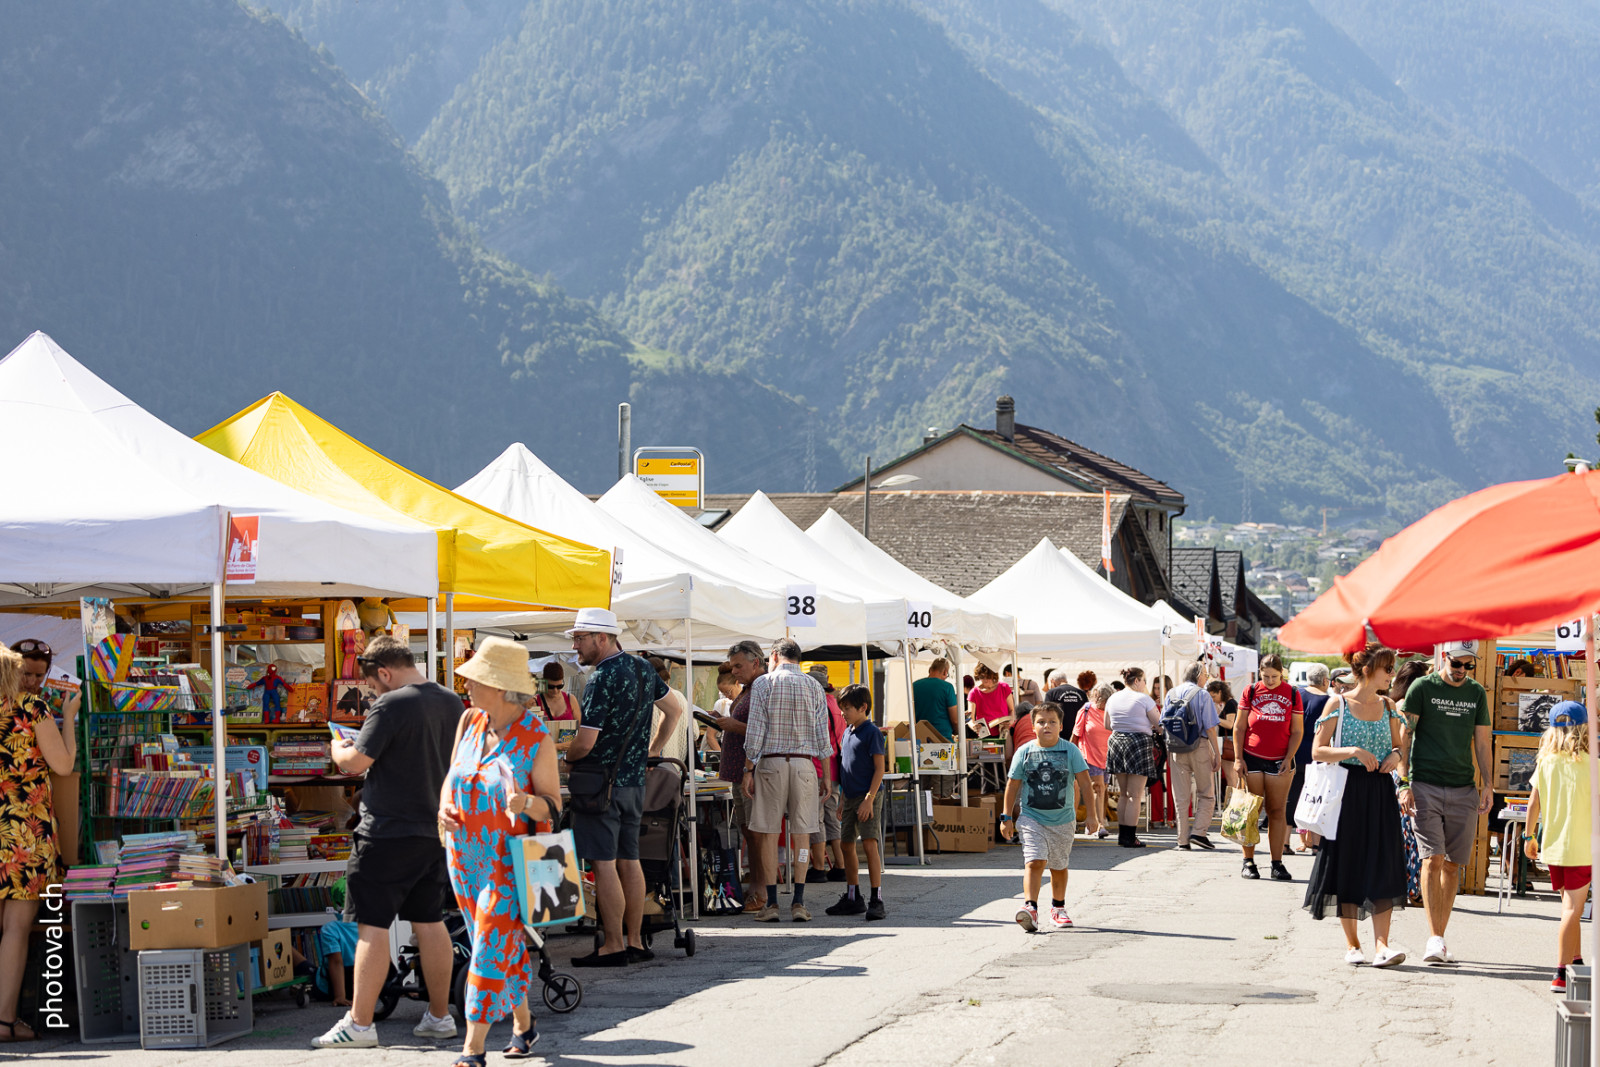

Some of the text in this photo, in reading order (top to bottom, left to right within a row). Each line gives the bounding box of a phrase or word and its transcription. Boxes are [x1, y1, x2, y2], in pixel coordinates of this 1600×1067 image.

[787, 595, 816, 616] 38
[907, 611, 932, 628] 40
[1431, 697, 1455, 706] OSAKA
[273, 965, 287, 979] COOP
